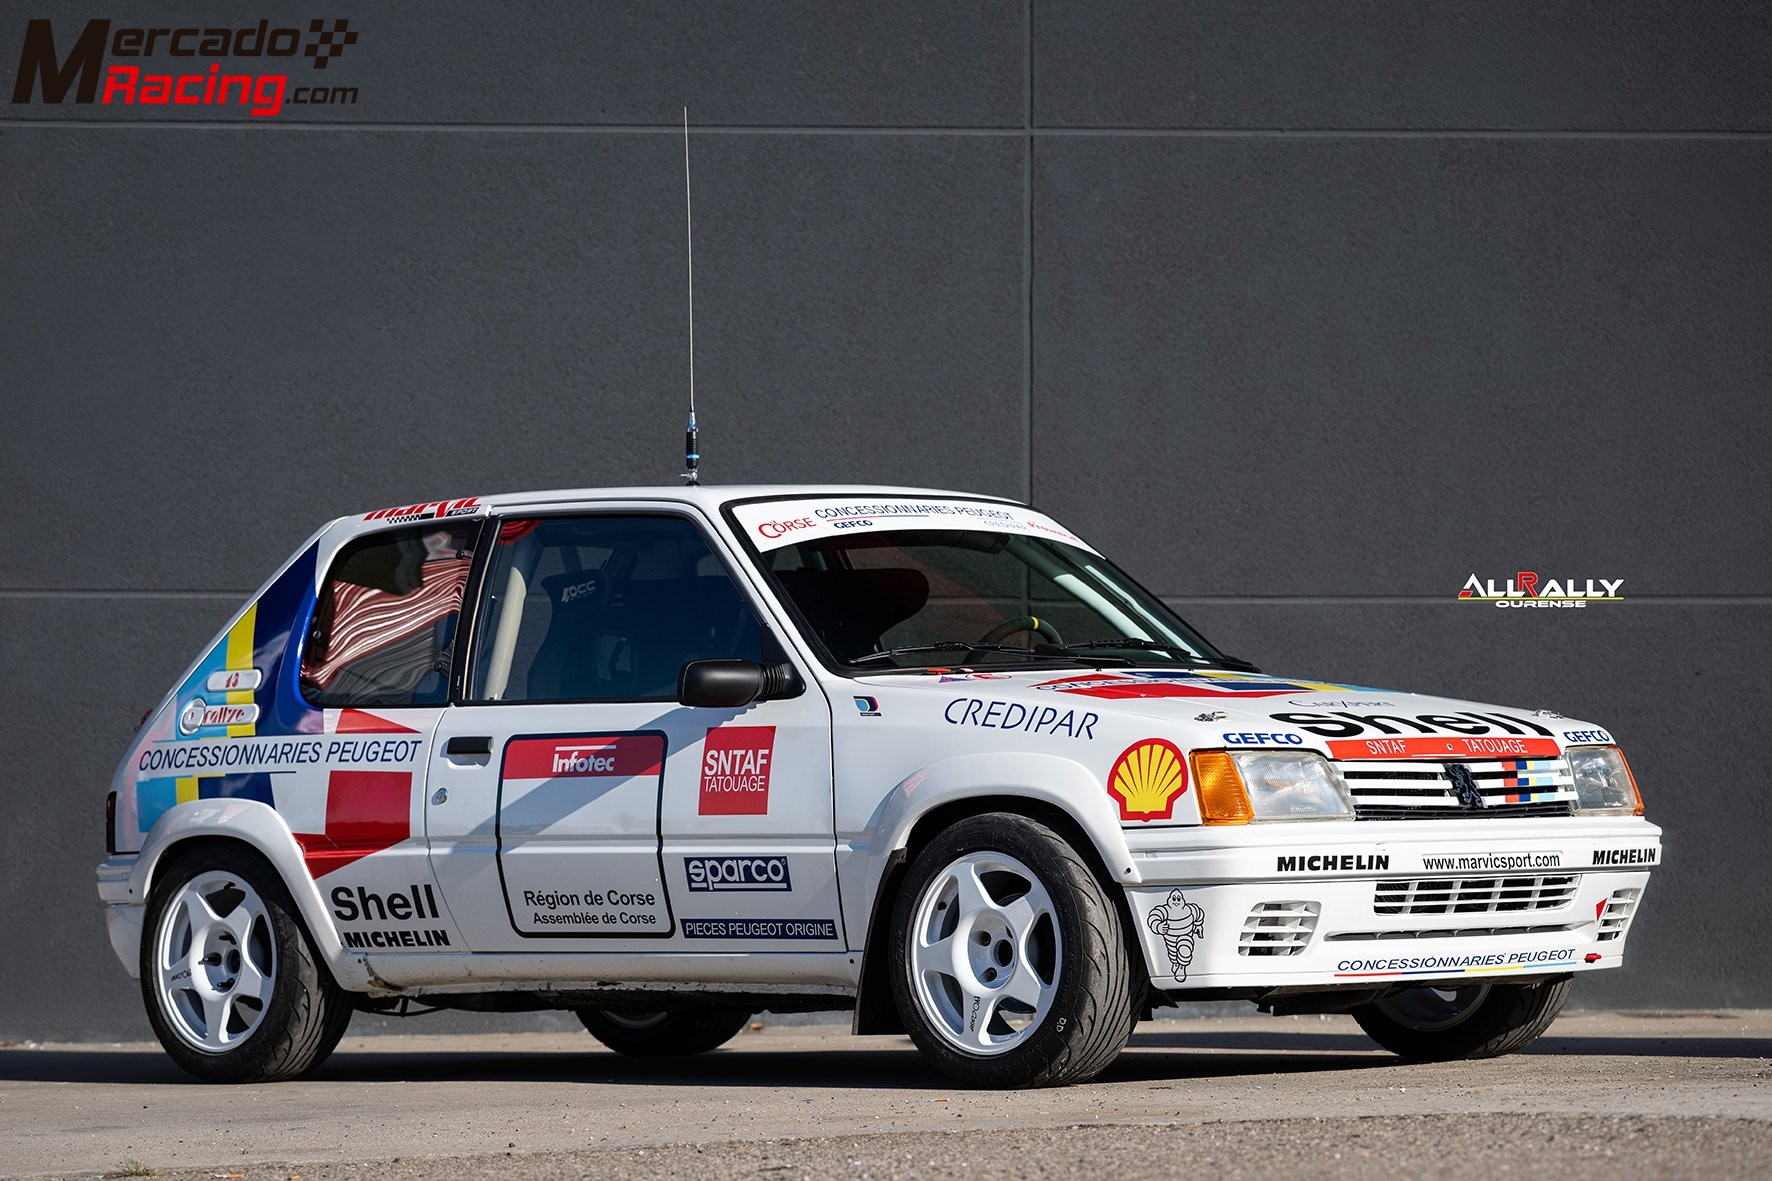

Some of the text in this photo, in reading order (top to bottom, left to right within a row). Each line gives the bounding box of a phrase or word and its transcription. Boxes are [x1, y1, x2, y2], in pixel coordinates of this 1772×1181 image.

[814, 504, 1014, 520] CONCESSIONNARIES PEUGEOT
[833, 519, 873, 529] GEFCO
[943, 697, 1099, 740] CREDIPAR
[1269, 711, 1556, 737] Shell
[1222, 732, 1304, 746] GEFCO
[1563, 730, 1611, 743] GEFCO
[139, 740, 423, 771] CONCESSIONNARIES PEUGEOT
[1365, 738, 1528, 755] SNTAF TATOUAGE
[552, 750, 616, 773] Infotec
[703, 749, 769, 776] SNTAF
[703, 775, 766, 793] TATOUAGE
[1276, 854, 1390, 872] MICHELIN
[1422, 852, 1561, 871] www.marvicsport.com
[1591, 848, 1656, 865] MICHELIN
[688, 858, 785, 890] sparco
[331, 884, 440, 921] Shell
[523, 889, 656, 909] Région de Corse
[533, 911, 657, 925] Assemblée de Corse
[685, 922, 834, 937] PIECES PEUGEOT ORIGINE
[343, 930, 451, 948] MICHELIN
[1337, 949, 1576, 972] CONCESSIONNARIES PEUGEOT
